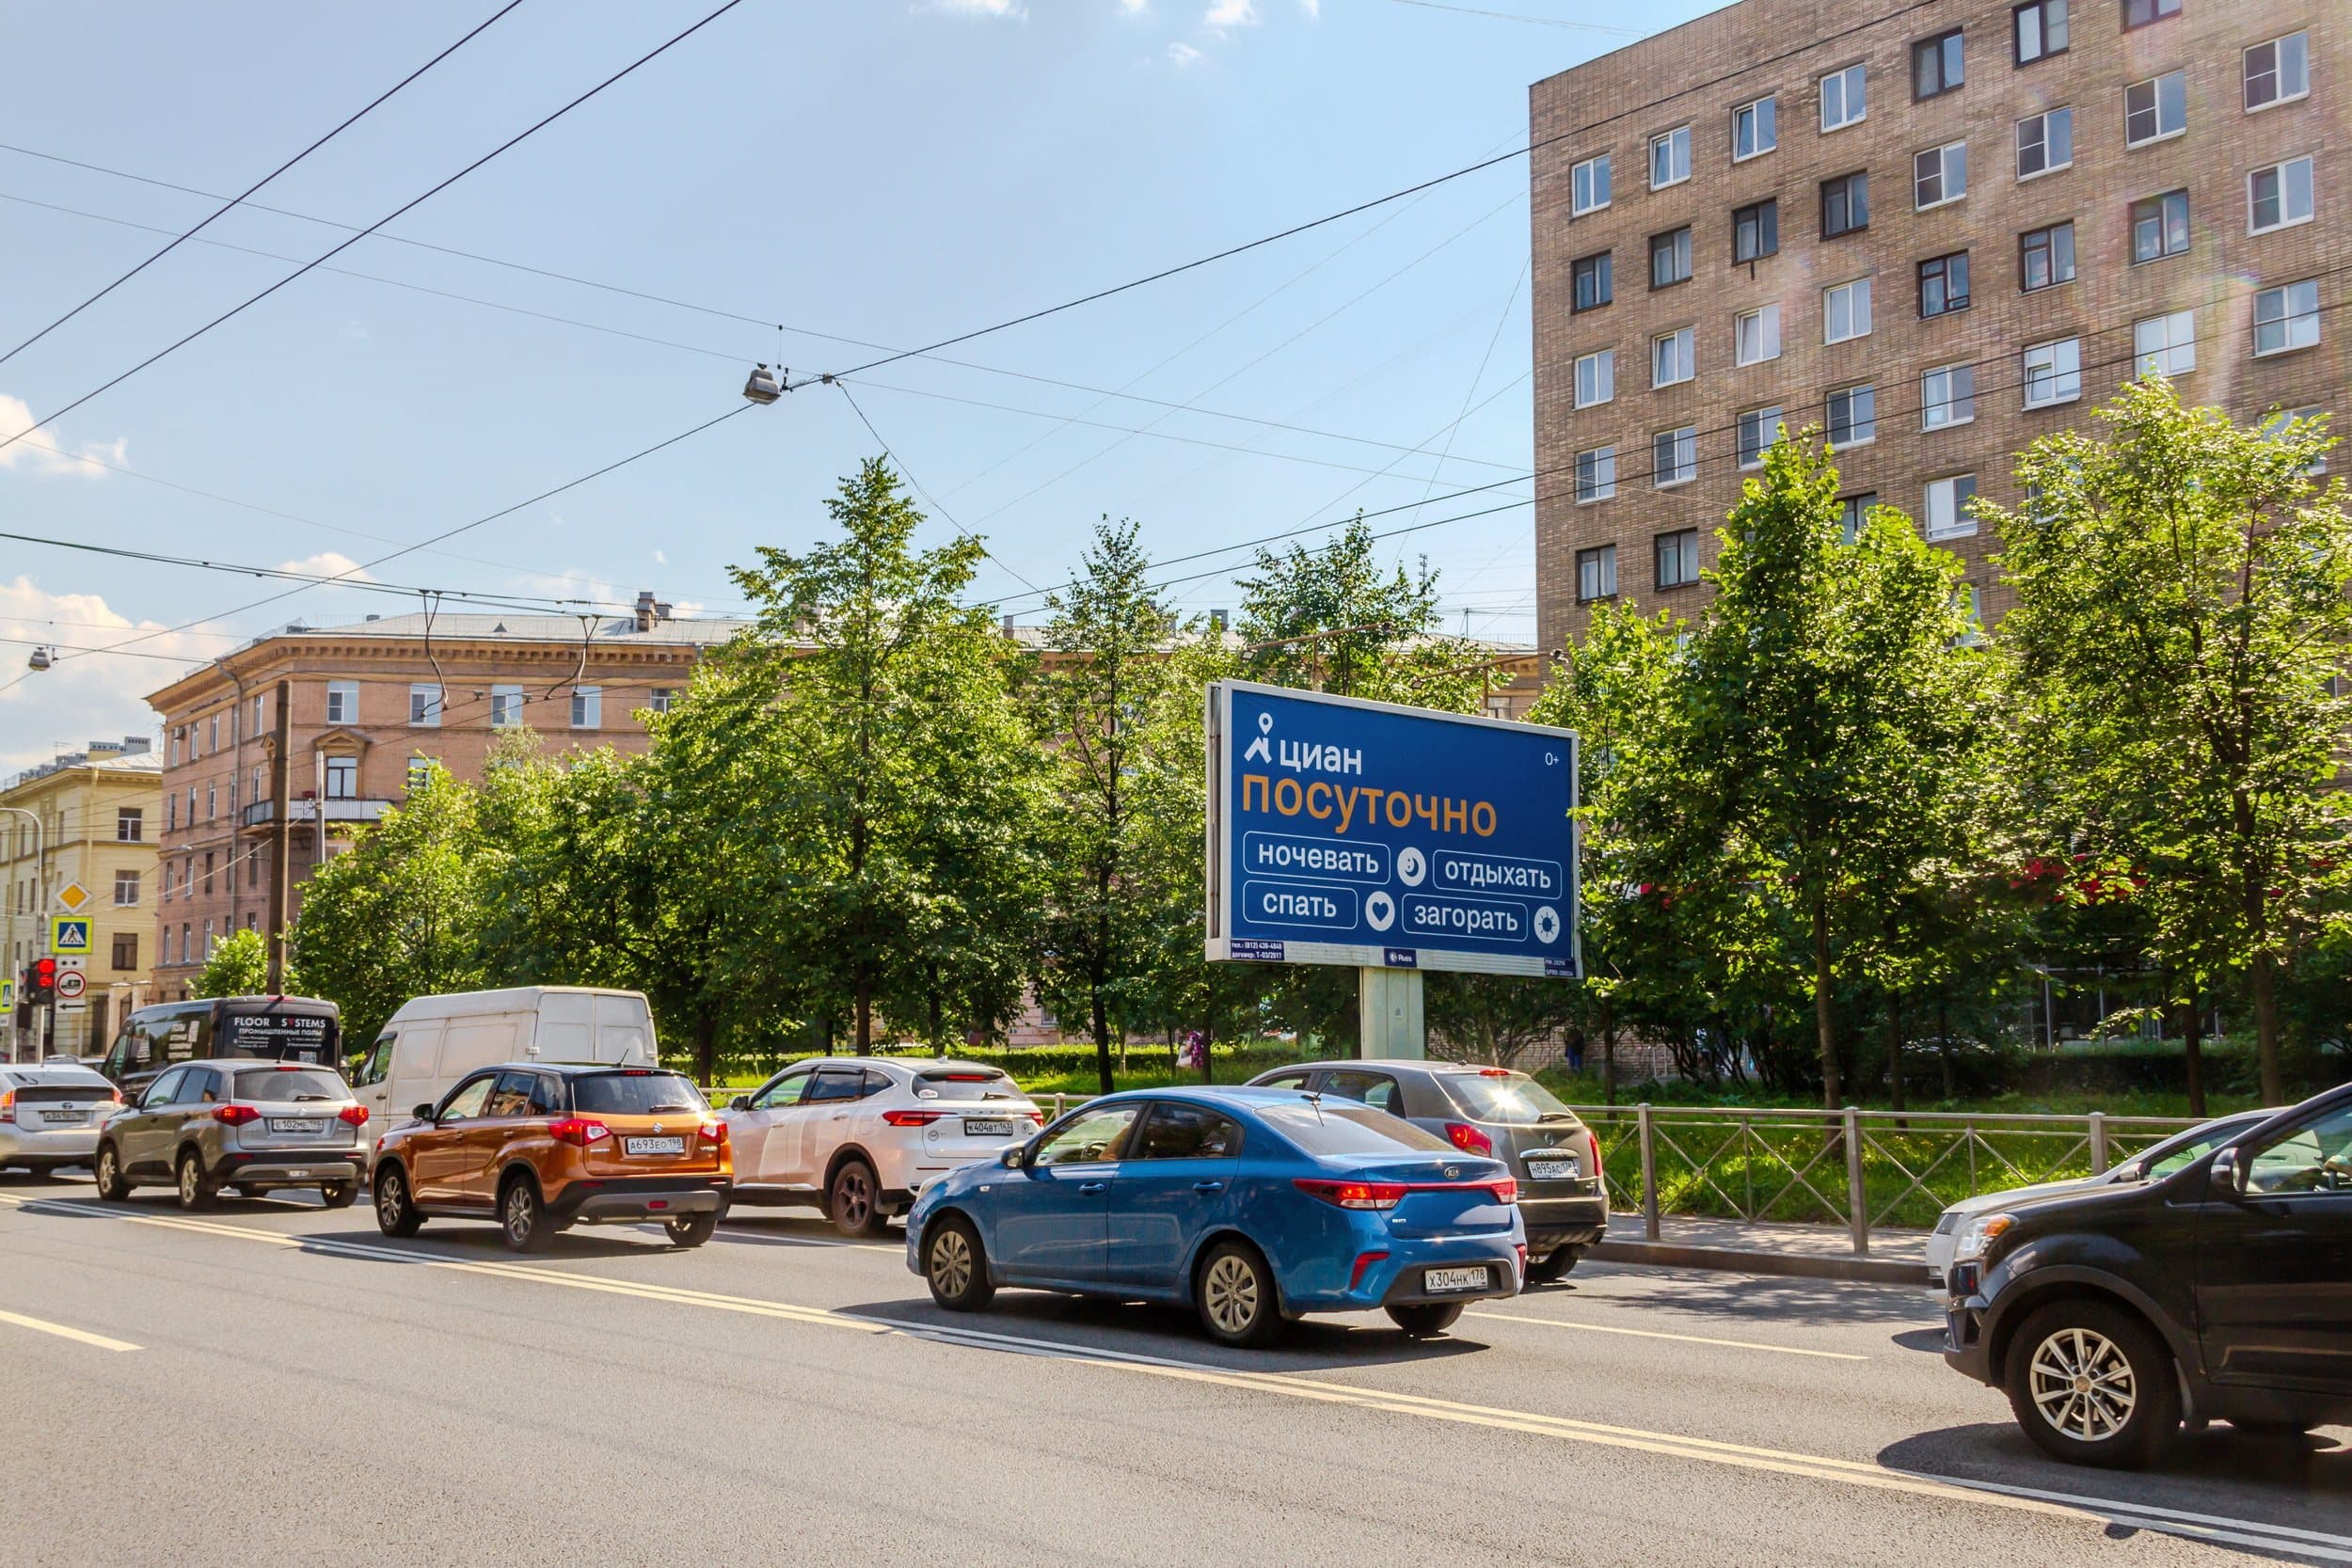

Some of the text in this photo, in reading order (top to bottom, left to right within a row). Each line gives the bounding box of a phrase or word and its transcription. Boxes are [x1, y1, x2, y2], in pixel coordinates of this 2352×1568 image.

[1545, 752, 1559, 766] 0+
[1243, 774, 1497, 836] посуточно
[1259, 843, 1379, 874] ночевать
[1445, 860, 1551, 889] отдыхать
[1263, 892, 1338, 918] спать
[1414, 902, 1519, 933] загорать
[234, 1017, 270, 1027] FLOOR
[1470, 1268, 1486, 1280] 178
